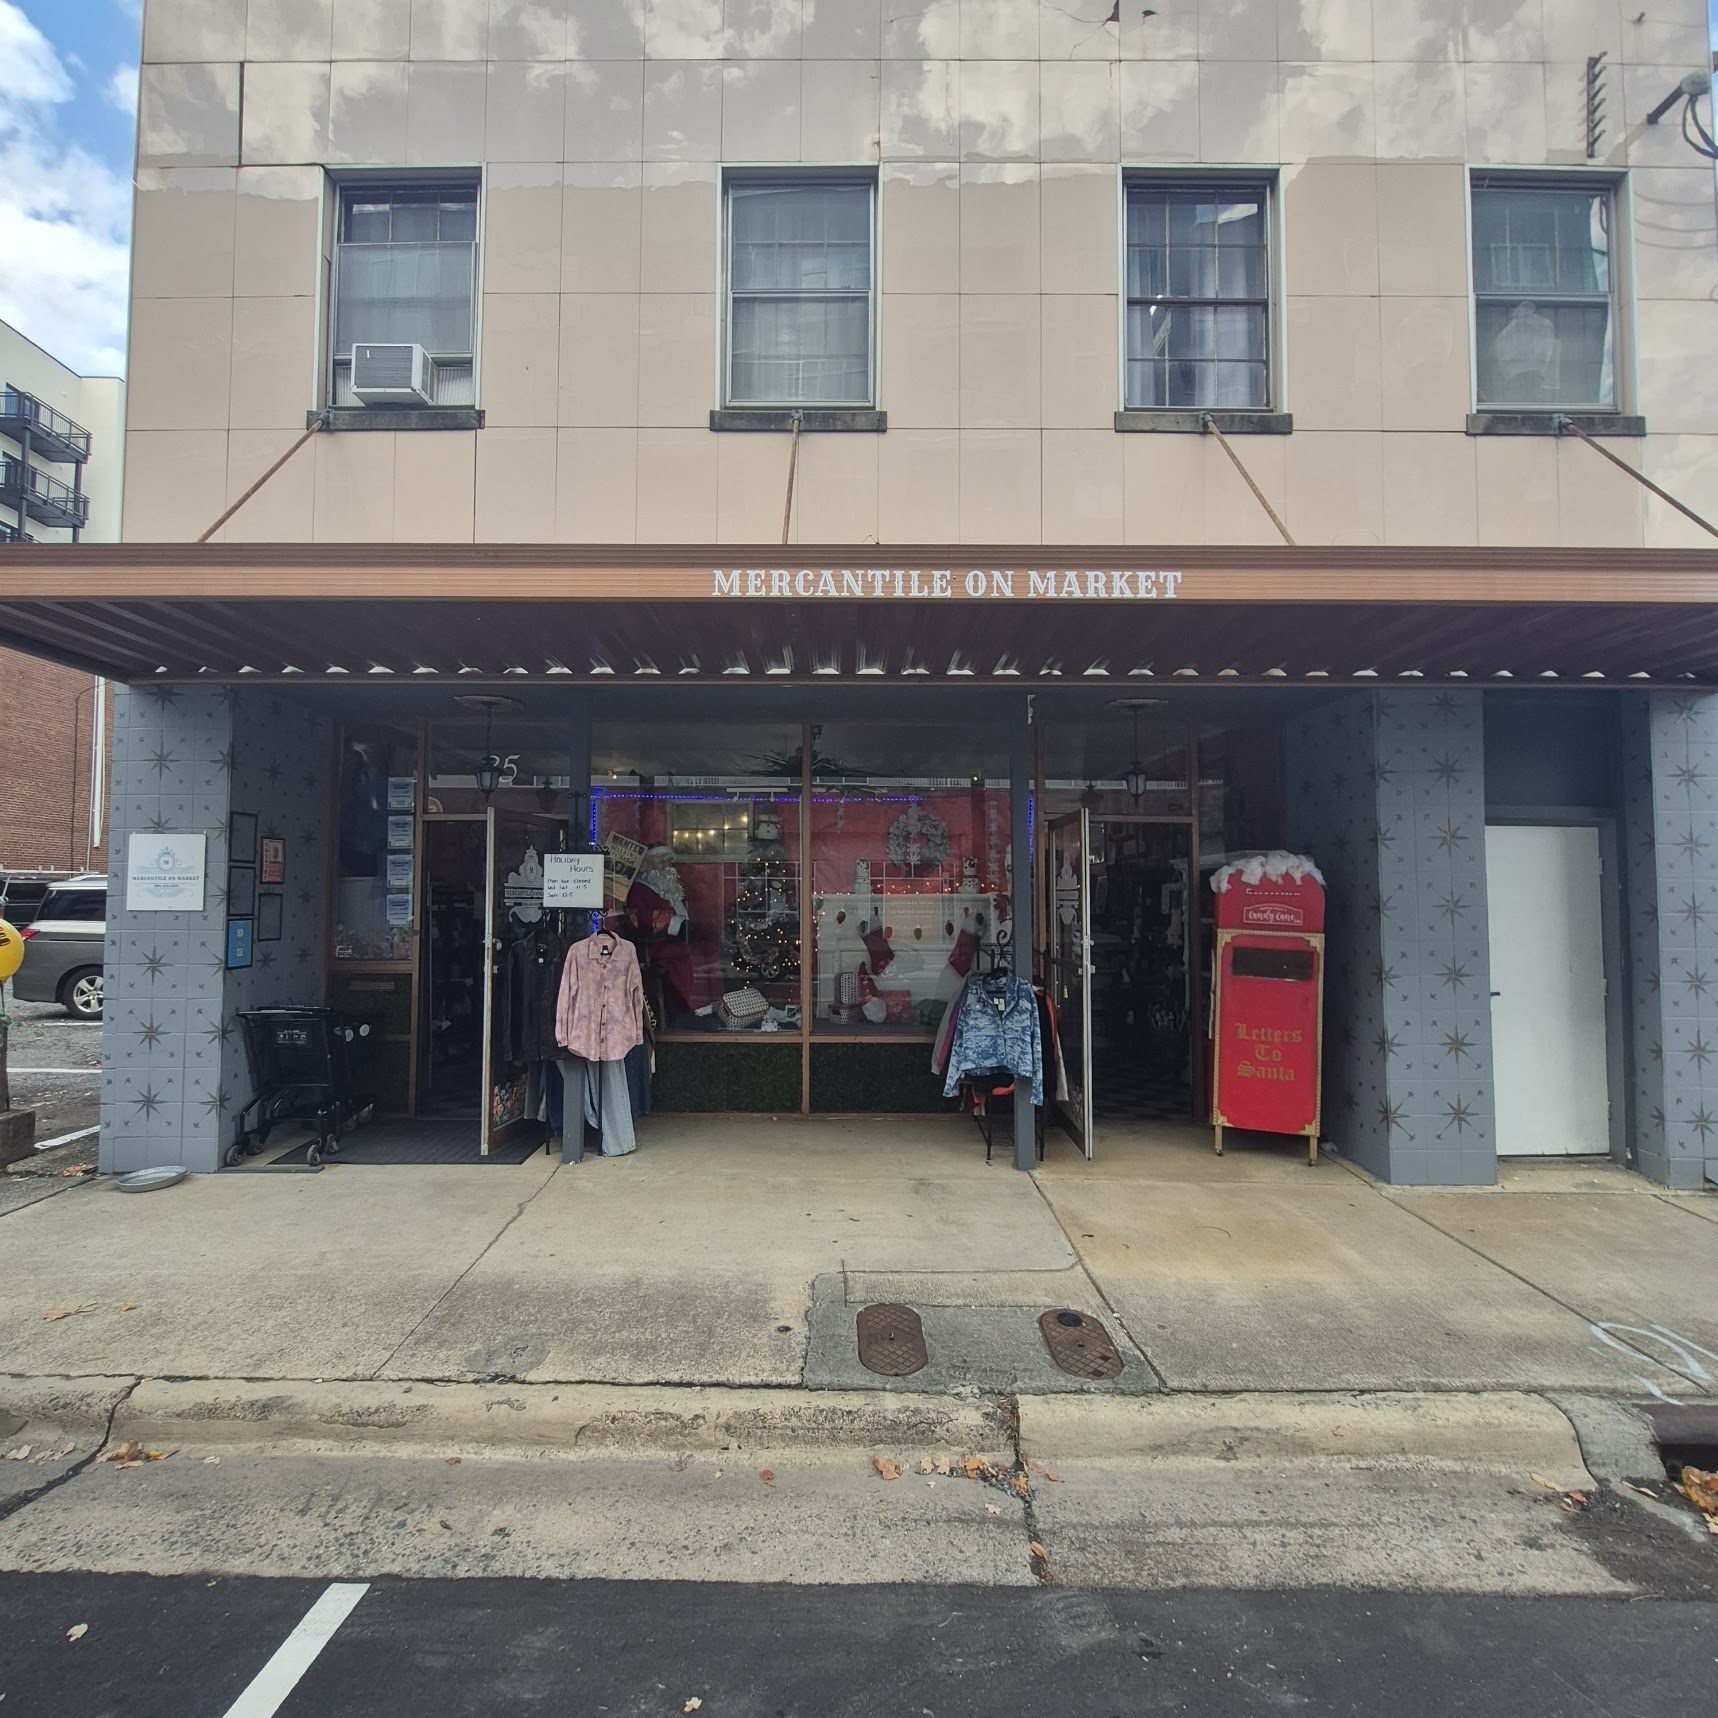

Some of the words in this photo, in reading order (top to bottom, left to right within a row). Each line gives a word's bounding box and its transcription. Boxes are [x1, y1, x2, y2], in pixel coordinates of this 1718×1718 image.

[712, 570, 951, 597] MERCANTILE
[965, 570, 1015, 597] ON
[1027, 570, 1182, 598] MARKET
[612, 834, 644, 856] WANTED
[570, 864, 594, 873] Hours
[1248, 909, 1274, 923] Candy
[1235, 1022, 1302, 1044] Letters
[1254, 1043, 1282, 1062] To
[1236, 1060, 1296, 1081] Santa
